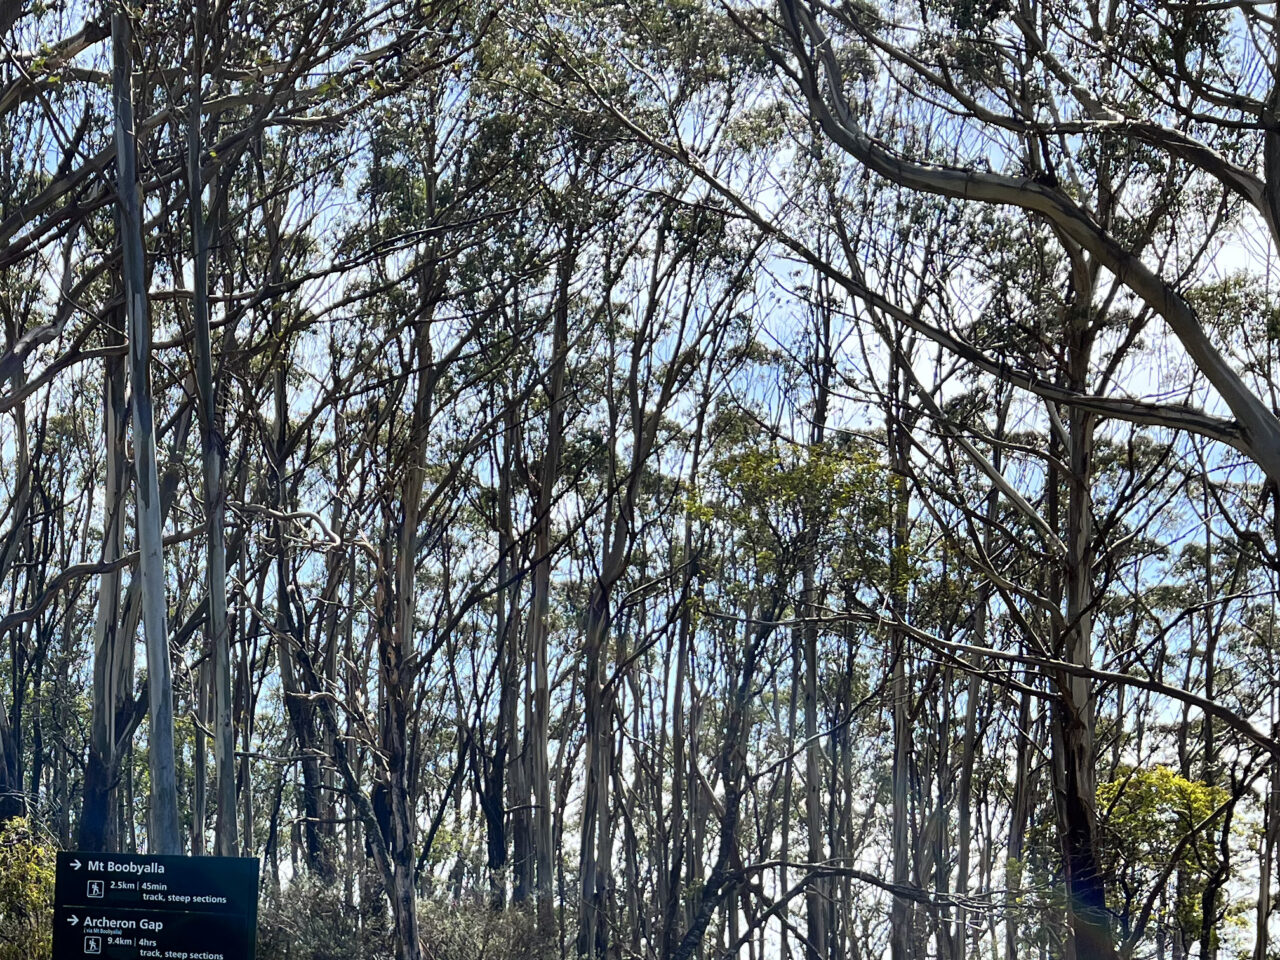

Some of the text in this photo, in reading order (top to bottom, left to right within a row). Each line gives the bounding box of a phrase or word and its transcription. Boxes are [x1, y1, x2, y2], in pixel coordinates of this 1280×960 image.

[88, 861, 165, 875] Mt Boobyalla
[110, 881, 167, 891] 2.5km 45min
[143, 893, 227, 904] track, steep sections
[83, 916, 163, 932] Archeron Gap
[107, 937, 157, 947] 9.4km 4hrs
[140, 949, 224, 960] track, steep sections
